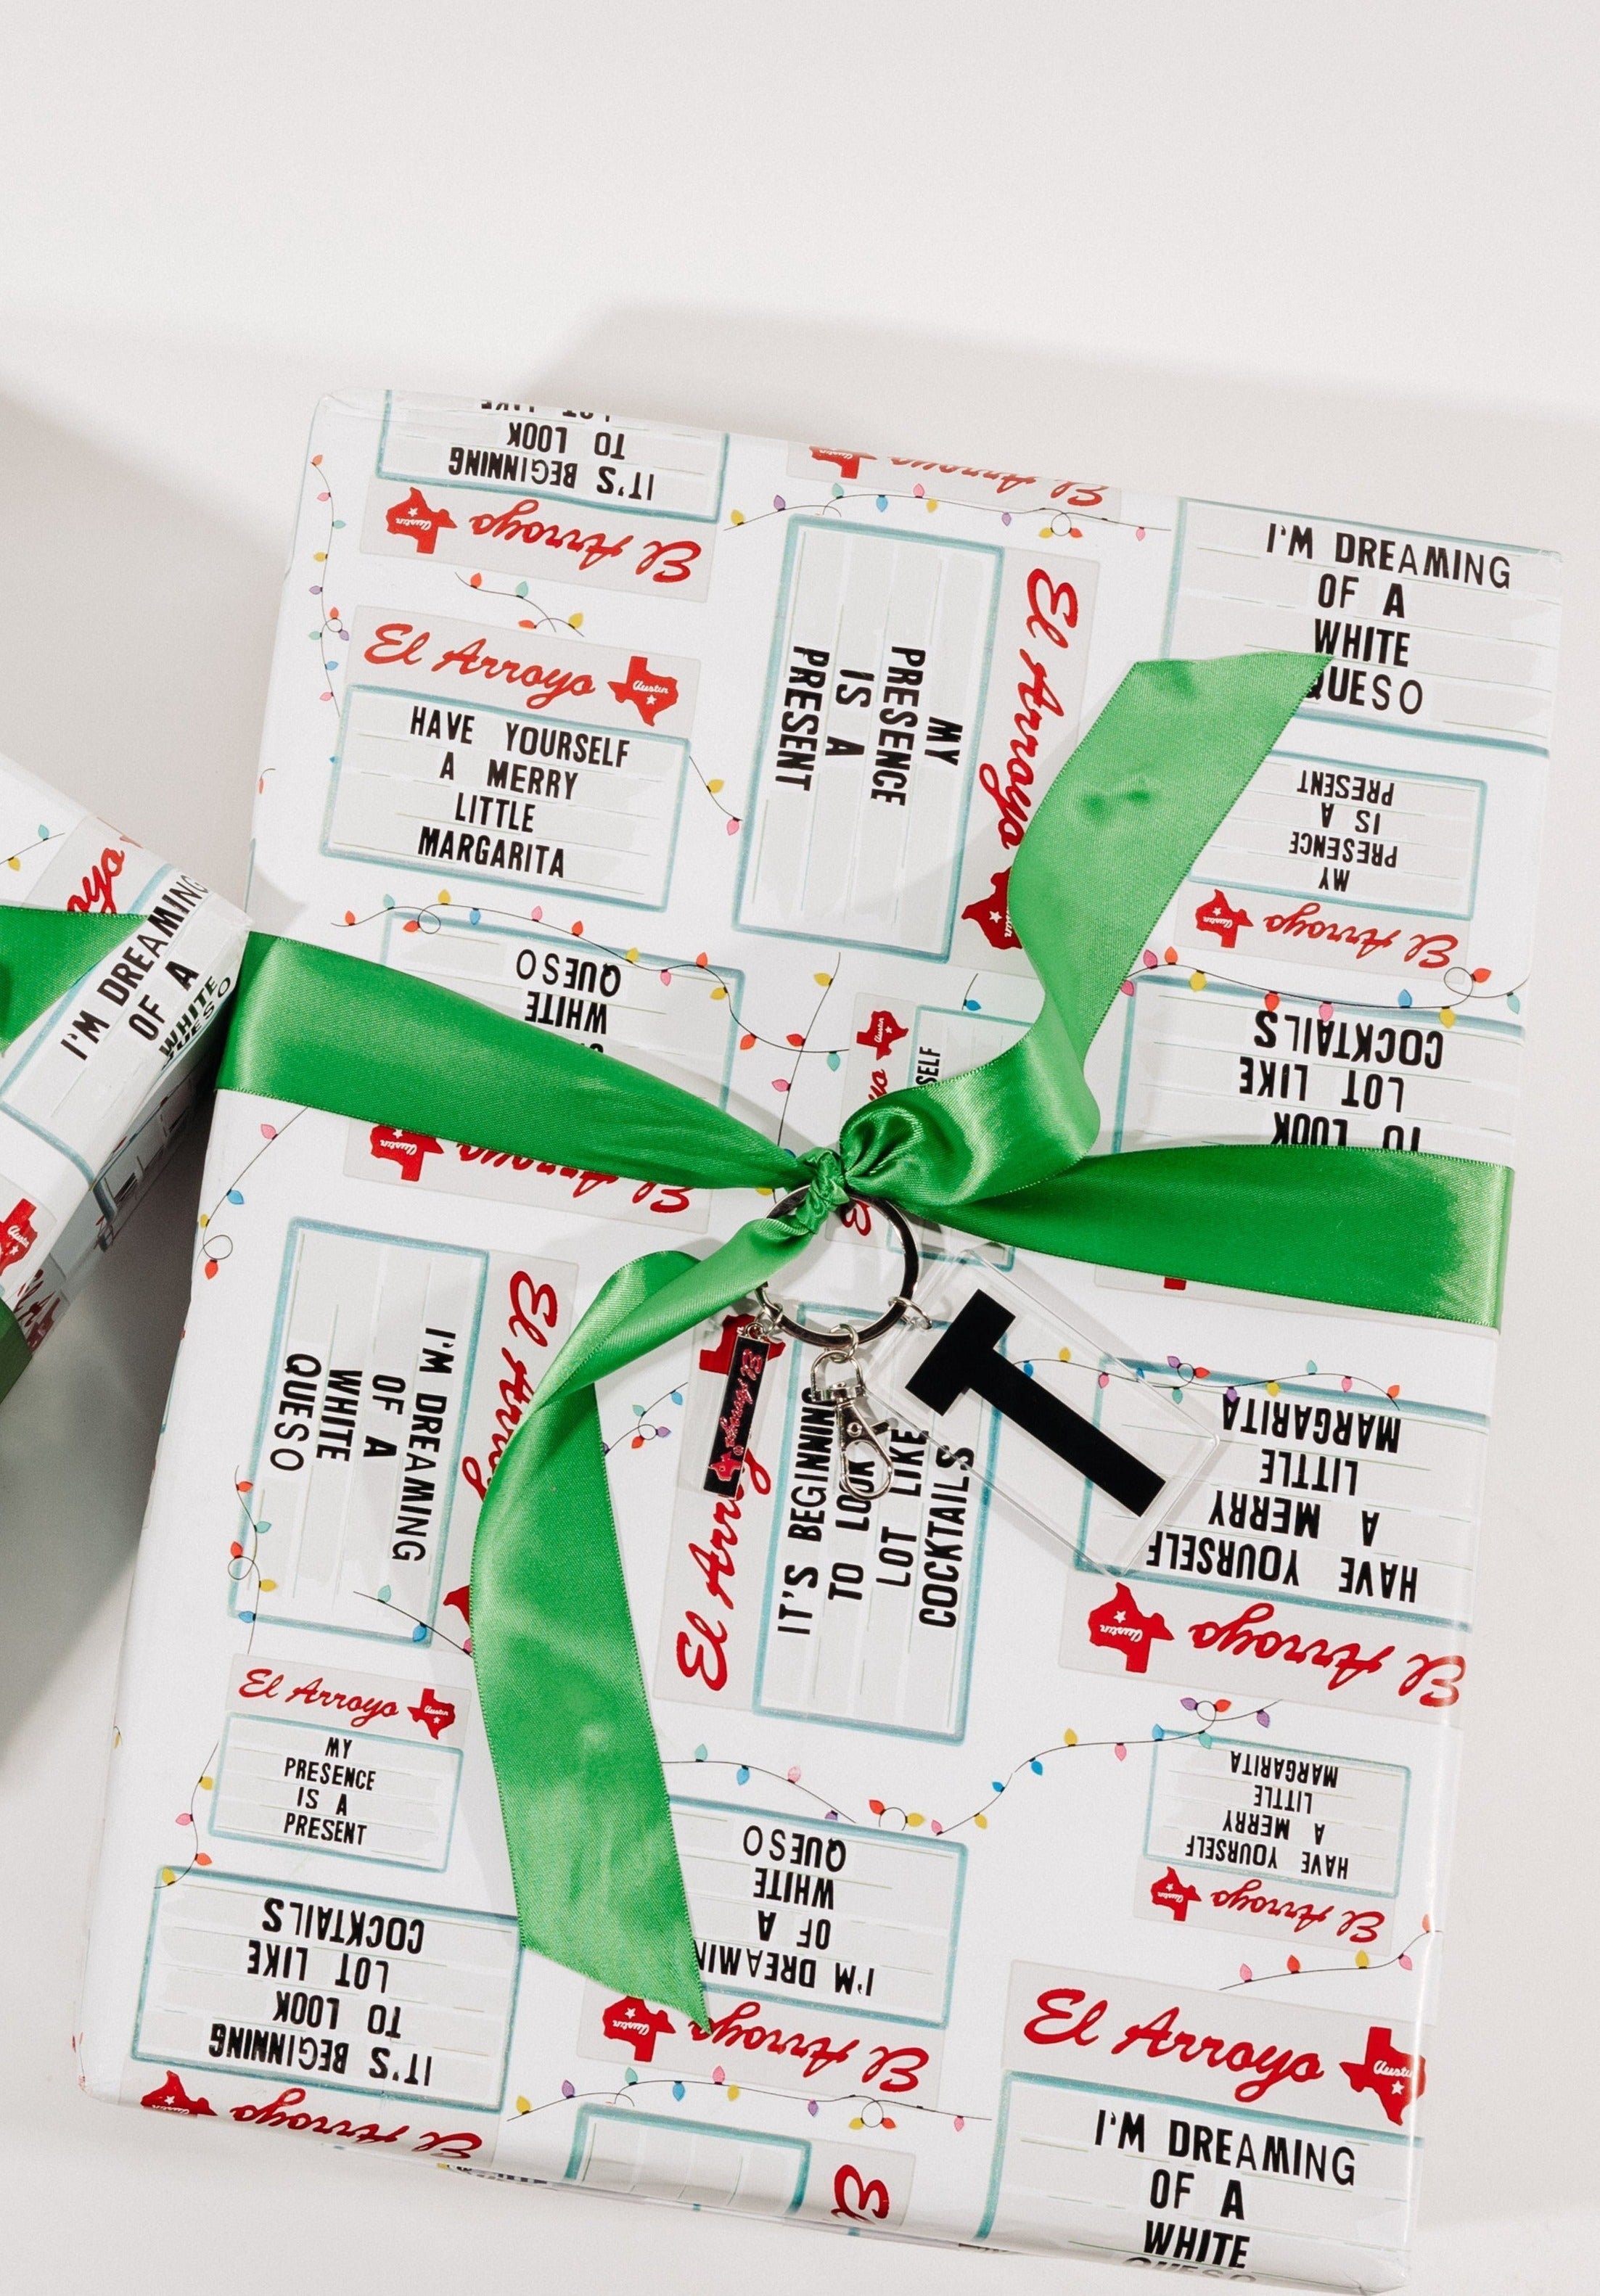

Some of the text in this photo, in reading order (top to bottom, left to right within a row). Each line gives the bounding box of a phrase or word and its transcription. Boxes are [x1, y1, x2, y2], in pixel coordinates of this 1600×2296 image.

[507, 422, 624, 459] TO LOOK
[449, 448, 654, 500] IT'S BEGINNING
[395, 517, 432, 530] Austin
[470, 499, 702, 583] El Arroyo
[1267, 524, 1509, 588] I'M DREAMING
[1318, 574, 1404, 618] OF A
[364, 623, 594, 709] El Arroyo
[1316, 619, 1410, 667] WHITE
[633, 680, 669, 696] Austin
[825, 670, 874, 755] IS A
[979, 568, 1079, 849] El Arroyo
[411, 707, 629, 767] HAVE YOURSELF
[776, 646, 829, 791] PRESENT
[871, 646, 925, 805] PRESENCE
[925, 717, 962, 765] MY
[440, 752, 578, 799] A MERRY
[1297, 770, 1394, 806] PRESENT
[456, 793, 535, 832] LITTLE
[1321, 802, 1380, 834] IS A
[418, 826, 563, 878] MARGARITA
[1289, 832, 1397, 868] PRESENCE
[1318, 868, 1350, 892] MY
[1265, 903, 1458, 968] El Arroyo
[61, 874, 209, 1060] I'M DREAMING
[517, 950, 620, 997] QUESO
[129, 961, 199, 1040] OF A
[159, 976, 218, 1057] WHITE
[525, 991, 607, 1034] WHITE
[1255, 1011, 1443, 1069] COCKTAILS
[1240, 1056, 1403, 1112] LOT LIKE
[381, 1138, 417, 1155] Austin
[1272, 1112, 1347, 1145] LOOK
[508, 1270, 558, 1346] El
[271, 1354, 321, 1470] QUESO
[316, 1370, 362, 1461] WHITE
[364, 1375, 406, 1457] OF A
[905, 1288, 1166, 1518] T
[1223, 1394, 1400, 1453] MARGARITA
[393, 1328, 456, 1560] I'M DREAMING
[1260, 1449, 1358, 1495] LITTLE
[828, 1456, 876, 1600] TO LOOK
[877, 1428, 930, 1587] LOT LIKE
[1208, 1491, 1379, 1546] A MERRY
[918, 1444, 975, 1629] COCKTAILS
[1146, 1531, 1417, 1602] HAVE YOURSELF
[778, 1565, 818, 1634] IT'S
[676, 1610, 728, 1691] El
[1099, 1624, 1143, 1642] Austin
[1189, 1602, 1466, 1708] El Arroyo
[239, 1668, 398, 1727] El Arroyo
[424, 1705, 448, 1716] Austin
[284, 1758, 376, 1790] PRESENCE
[325, 1737, 352, 1758] MY
[1231, 1751, 1338, 1787] MARGARITA
[298, 1787, 346, 1816] IS A
[1254, 1785, 1312, 1814] LITTLE
[284, 1813, 366, 1845] PRESENT
[744, 1826, 845, 1872] QUESO
[1223, 1810, 1325, 1845] A MERRY
[1186, 1835, 1347, 1879] HAVE YOURSELF
[754, 1867, 833, 1909] WHITE
[1211, 1879, 1385, 1943] El Arroyo
[263, 1898, 424, 1954] COCKTAILS
[758, 1910, 831, 1949] OF A
[247, 1940, 388, 1993] LOT LIKE
[697, 1942, 874, 1996] I'M DREAMIN
[273, 1991, 401, 2038] TO LOOK
[612, 2019, 649, 2036] Austin
[209, 2024, 432, 2086] IT'S BEGINNING
[861, 2046, 929, 2093] El
[1023, 1988, 1324, 2103] El Arroyo
[230, 2088, 409, 2142] Arroyo
[1095, 2110, 1354, 2185] I'M DREAMING
[1150, 2169, 1244, 2220] OF A
[1144, 2221, 1250, 2268] WHITE
